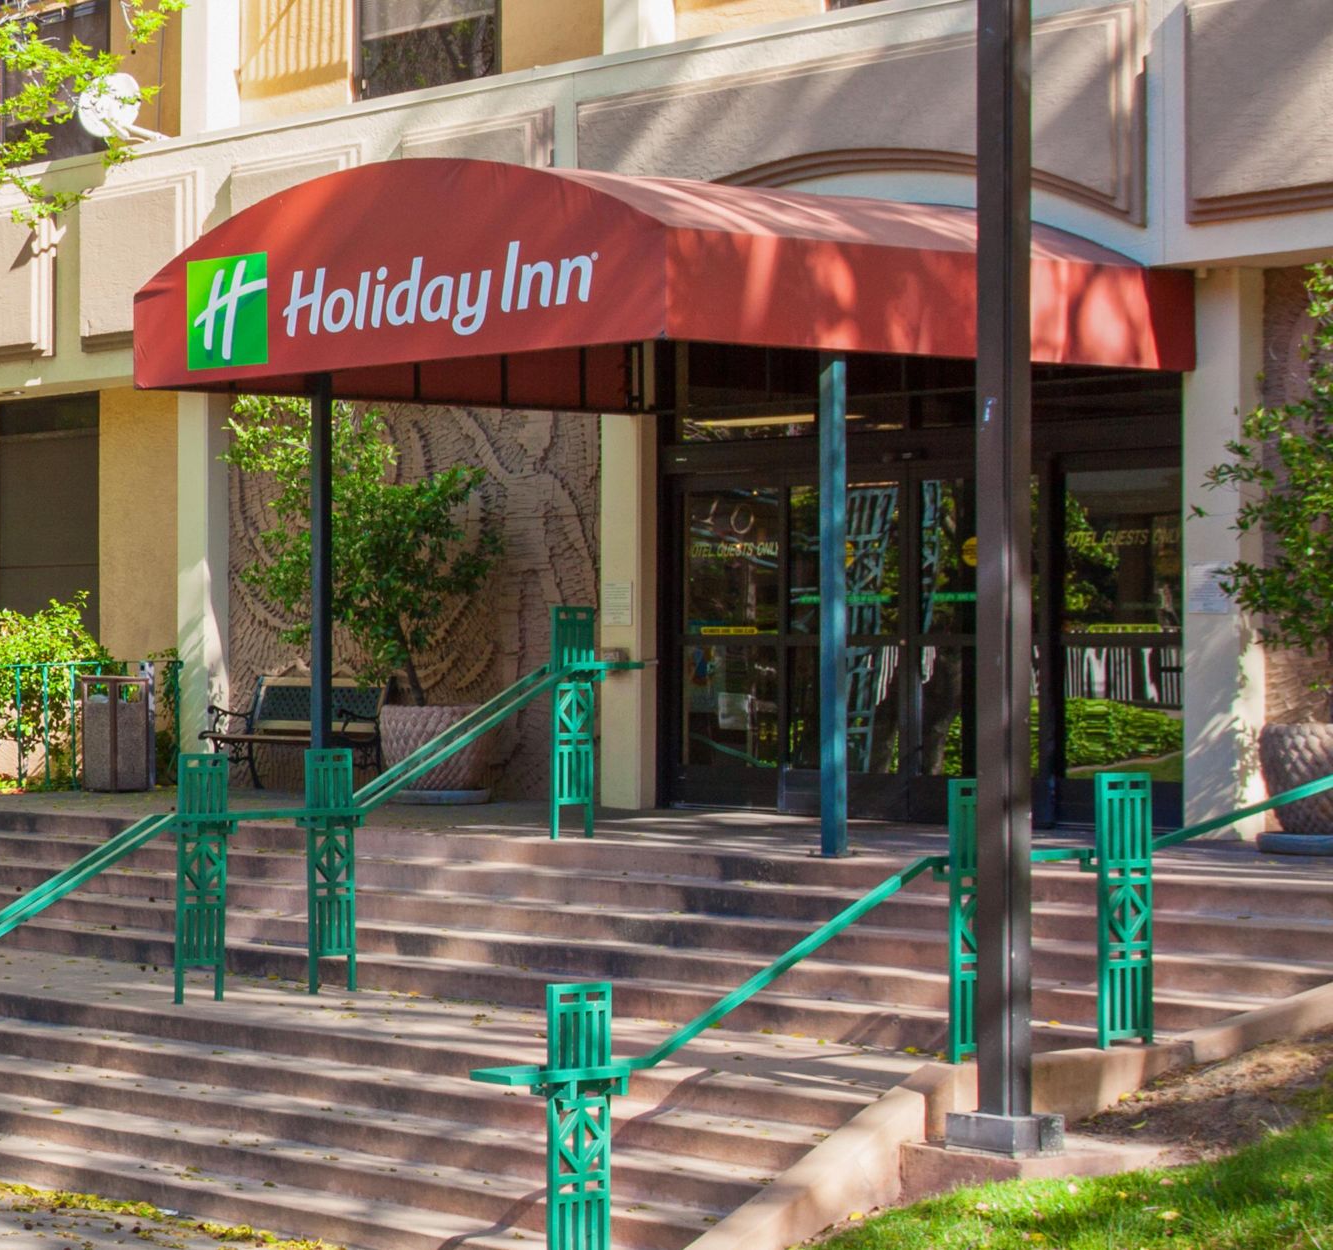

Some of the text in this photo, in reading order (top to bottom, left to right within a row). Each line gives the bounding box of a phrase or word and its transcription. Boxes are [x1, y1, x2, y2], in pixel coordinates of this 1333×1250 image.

[282, 256, 493, 336] Holiday
[1103, 528, 1149, 545] GUESTS
[691, 542, 716, 558] OTEL
